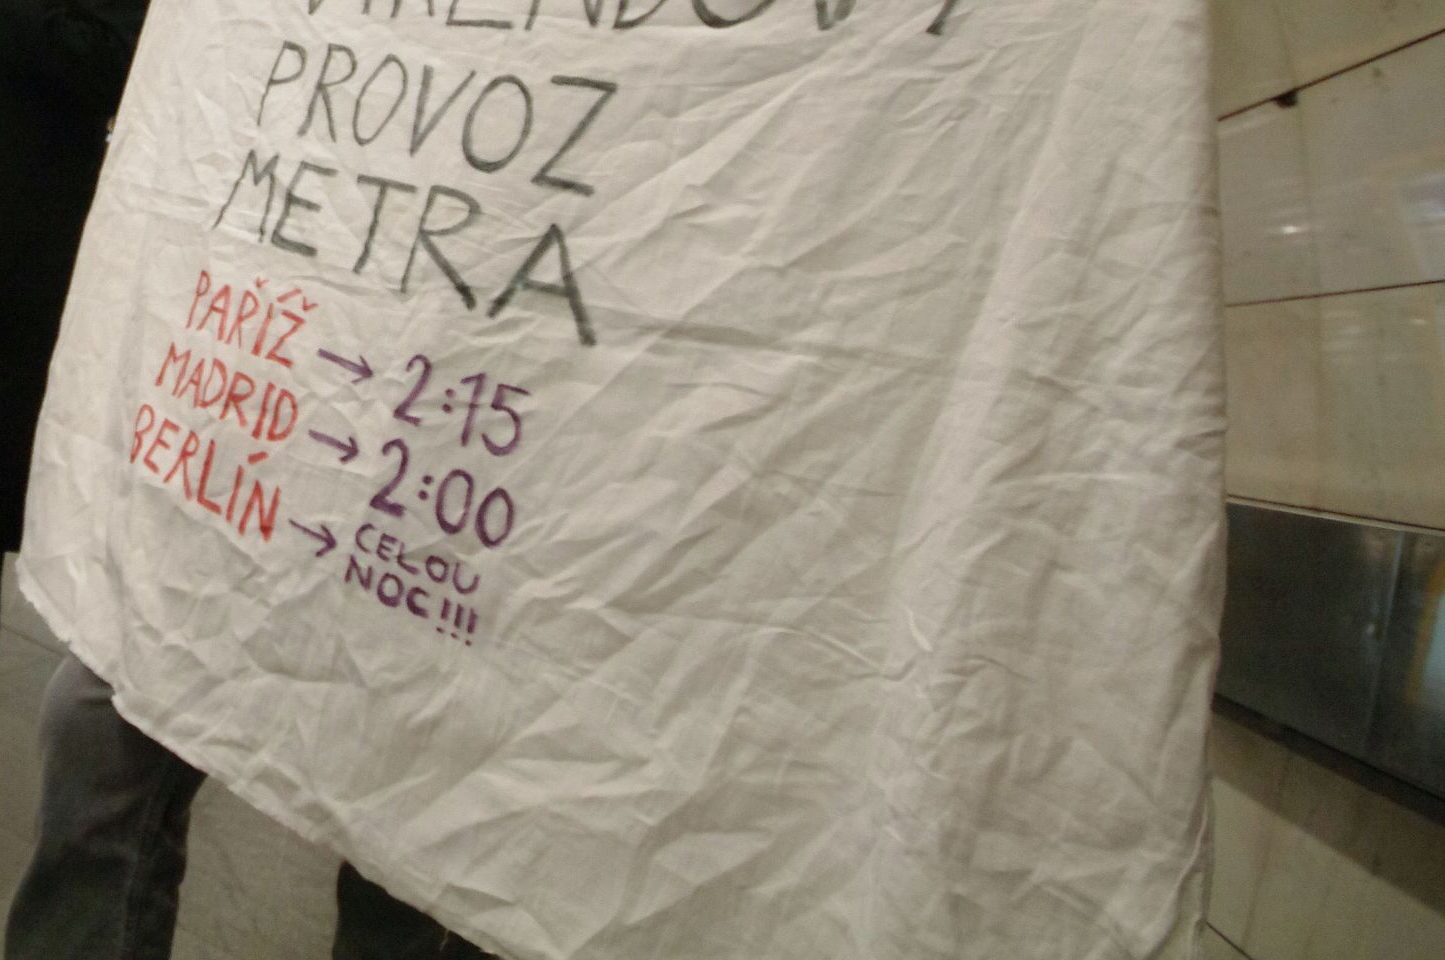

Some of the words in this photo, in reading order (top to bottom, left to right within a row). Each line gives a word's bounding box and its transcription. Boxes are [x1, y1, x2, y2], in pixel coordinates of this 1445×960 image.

[258, 40, 618, 197] PROVOZ
[210, 148, 597, 347] METRA
[155, 341, 299, 441] MADRID
[369, 438, 516, 548] 2:00
[185, 270, 318, 369] PAŘÍŽ
[393, 353, 531, 457] 2:15
[129, 403, 282, 542] BERLÍN
[354, 522, 481, 595] CELOU
[344, 555, 479, 646] NOC!!!
